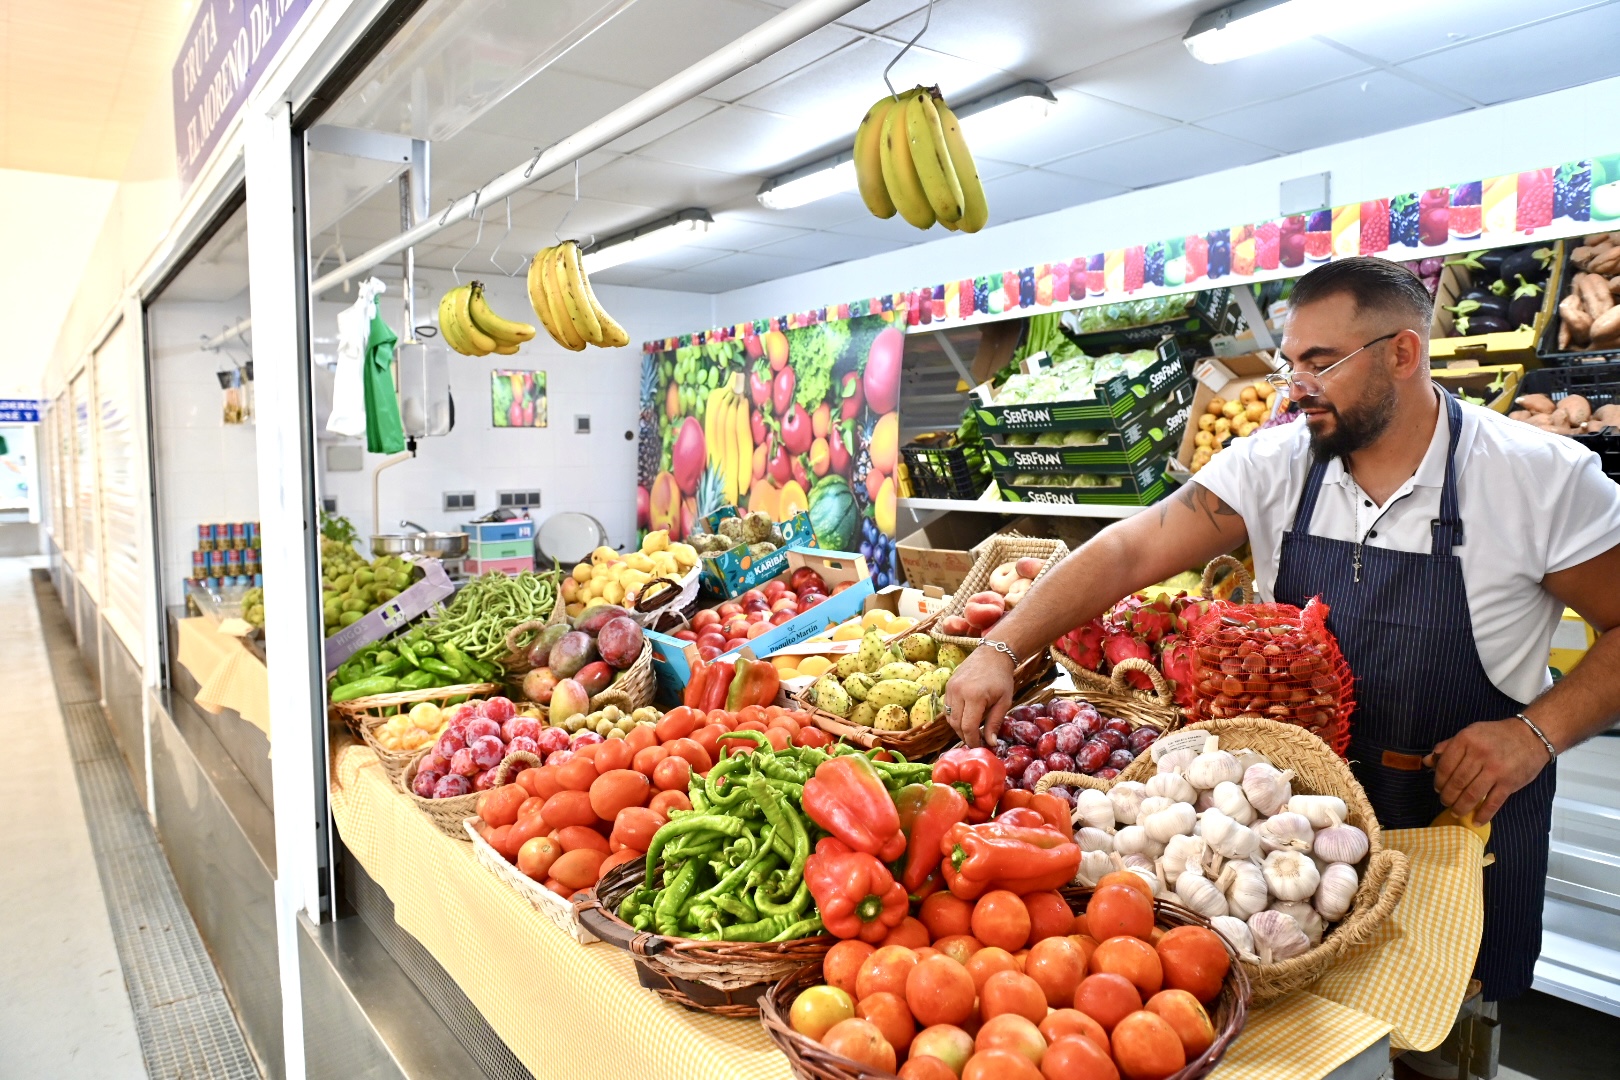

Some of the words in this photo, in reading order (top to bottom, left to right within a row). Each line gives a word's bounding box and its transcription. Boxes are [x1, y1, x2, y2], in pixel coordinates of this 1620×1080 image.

[187, 115, 200, 166] EL
[199, 27, 249, 147] MORENO
[250, 0, 273, 65] DE
[1166, 404, 1192, 431] SERFRA
[336, 622, 369, 646] HIGOS
